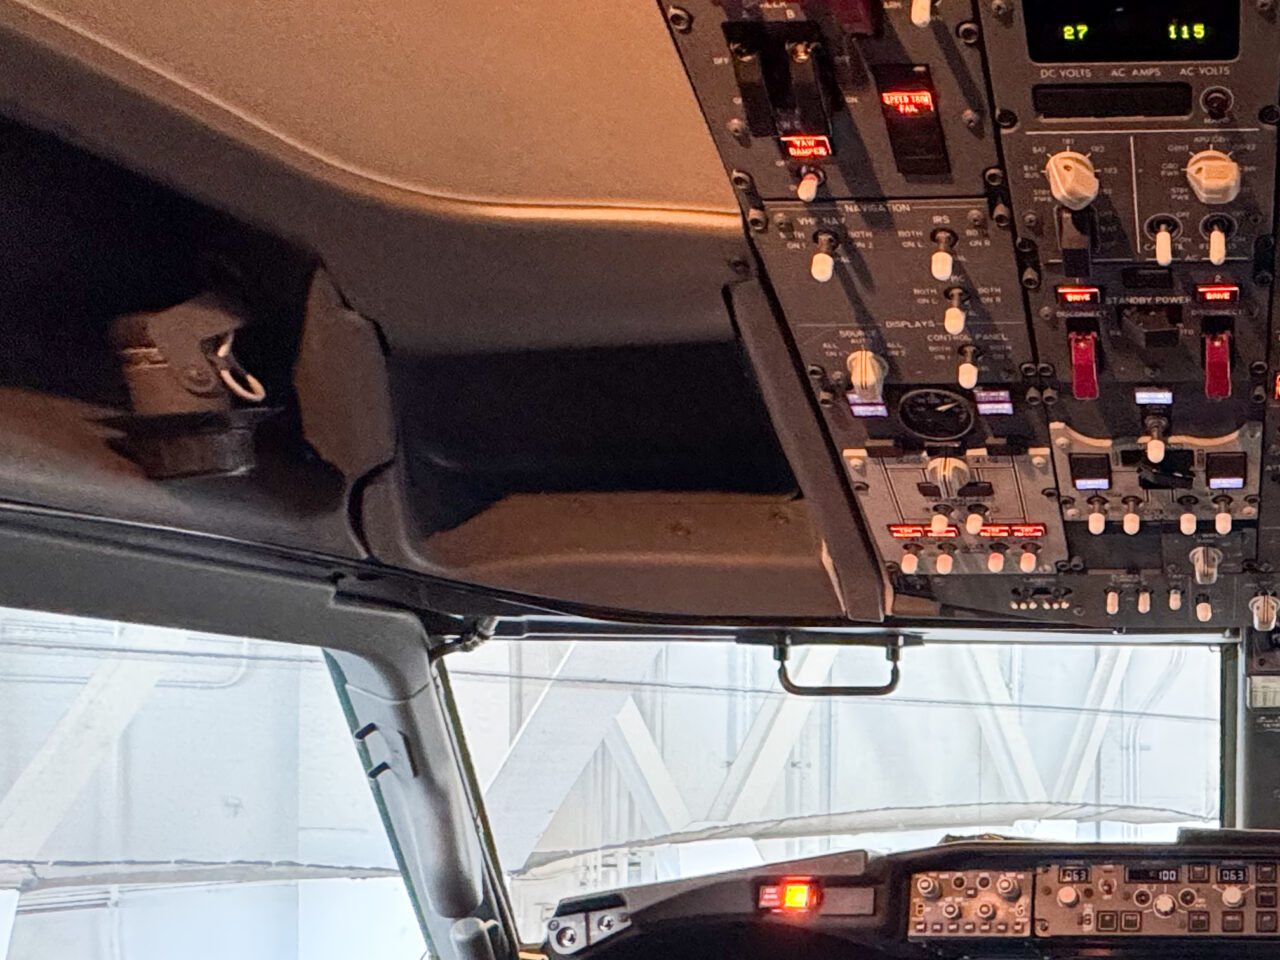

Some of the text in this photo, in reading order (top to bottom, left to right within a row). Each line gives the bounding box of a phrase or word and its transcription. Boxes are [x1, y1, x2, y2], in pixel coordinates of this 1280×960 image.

[1062, 24, 1206, 40] 27 115
[1040, 68, 1093, 79] DC VOLTS
[1111, 67, 1162, 78] AC AMPS
[1179, 66, 1231, 77] AC VOLTS
[899, 104, 919, 114] FAIL
[788, 147, 827, 156] DAMPER
[844, 204, 911, 213] NAVIGATION
[932, 216, 951, 225] IRS
[1066, 293, 1091, 302] DRIVE
[1106, 295, 1192, 305] STANDBY POWER
[1205, 291, 1230, 301] DRIVE
[885, 320, 936, 329] DISPLAYS
[1159, 870, 1177, 881] 100
[1222, 870, 1244, 881] 063
